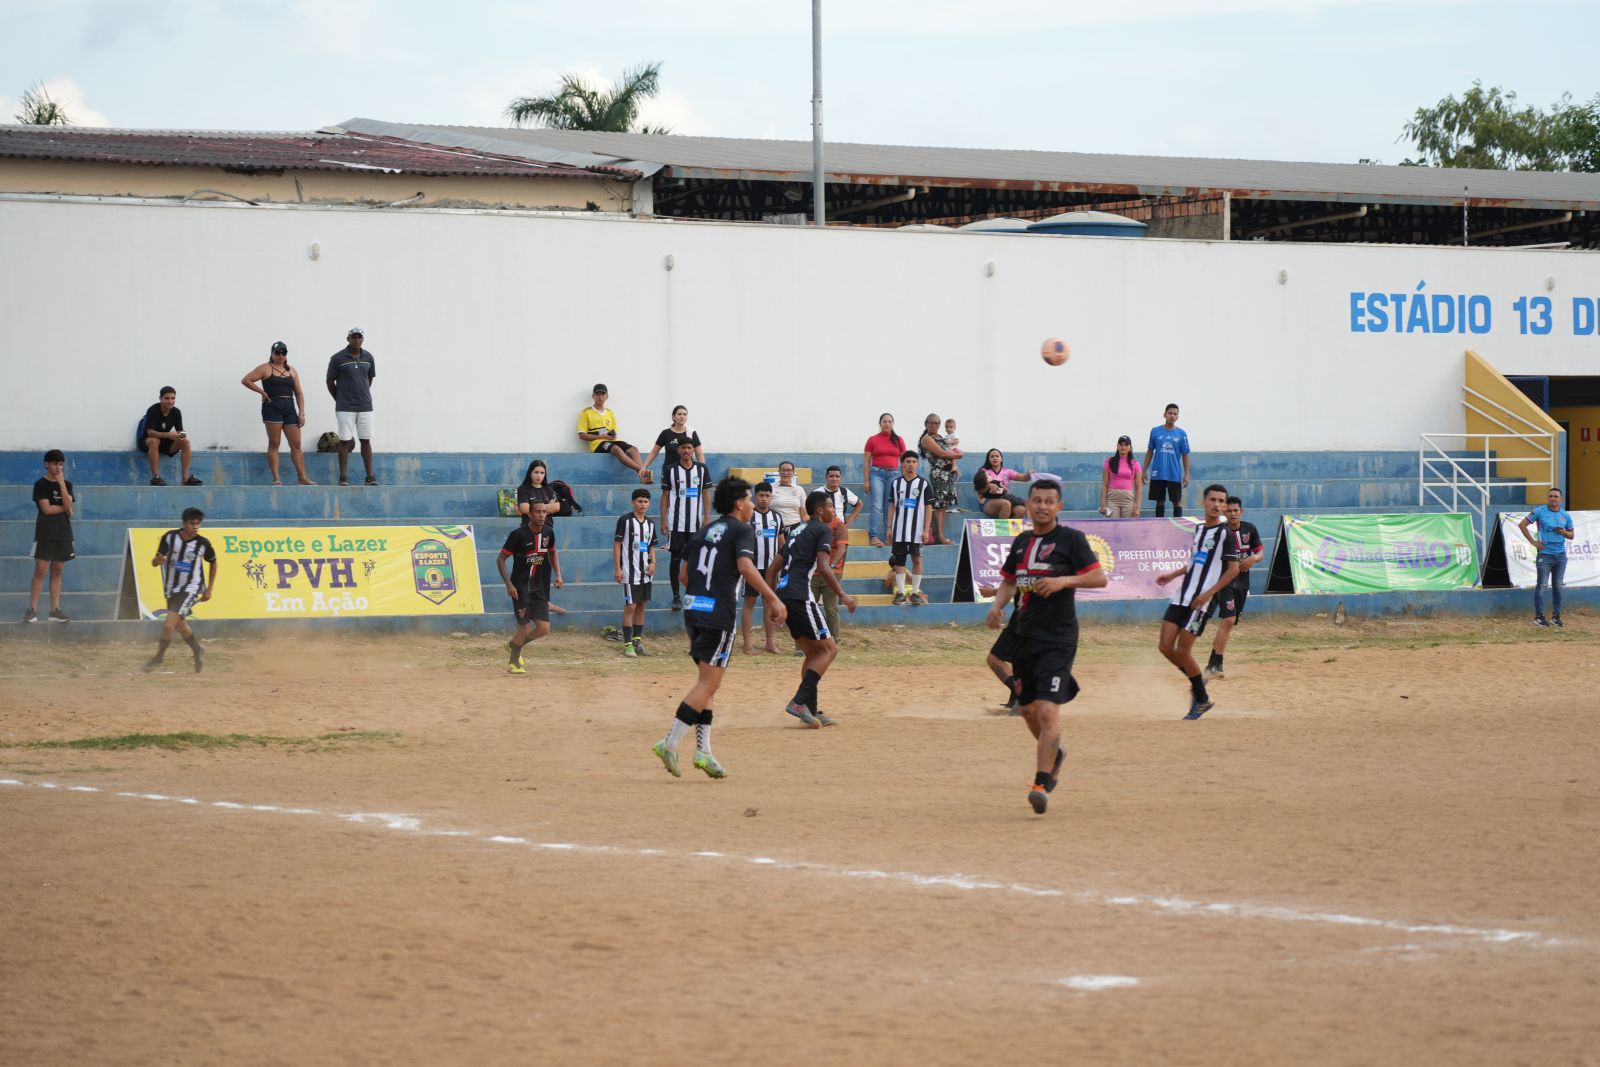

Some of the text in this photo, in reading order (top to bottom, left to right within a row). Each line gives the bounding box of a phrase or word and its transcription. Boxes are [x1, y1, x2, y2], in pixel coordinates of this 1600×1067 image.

[1350, 280, 1600, 336] ESTÁDIO 13 D
[223, 534, 388, 557] Esporte e Lazer
[1118, 550, 1171, 561] PREFEITURA
[1172, 549, 1187, 559] DO
[414, 552, 449, 560] ESPORTE
[273, 558, 358, 589] PVH
[697, 546, 719, 592] 4
[979, 569, 1001, 578] SECRE
[1138, 562, 1151, 572] DE
[1152, 561, 1183, 571] PORTO
[265, 591, 369, 615] Em Ação
[1050, 676, 1061, 692] 9
